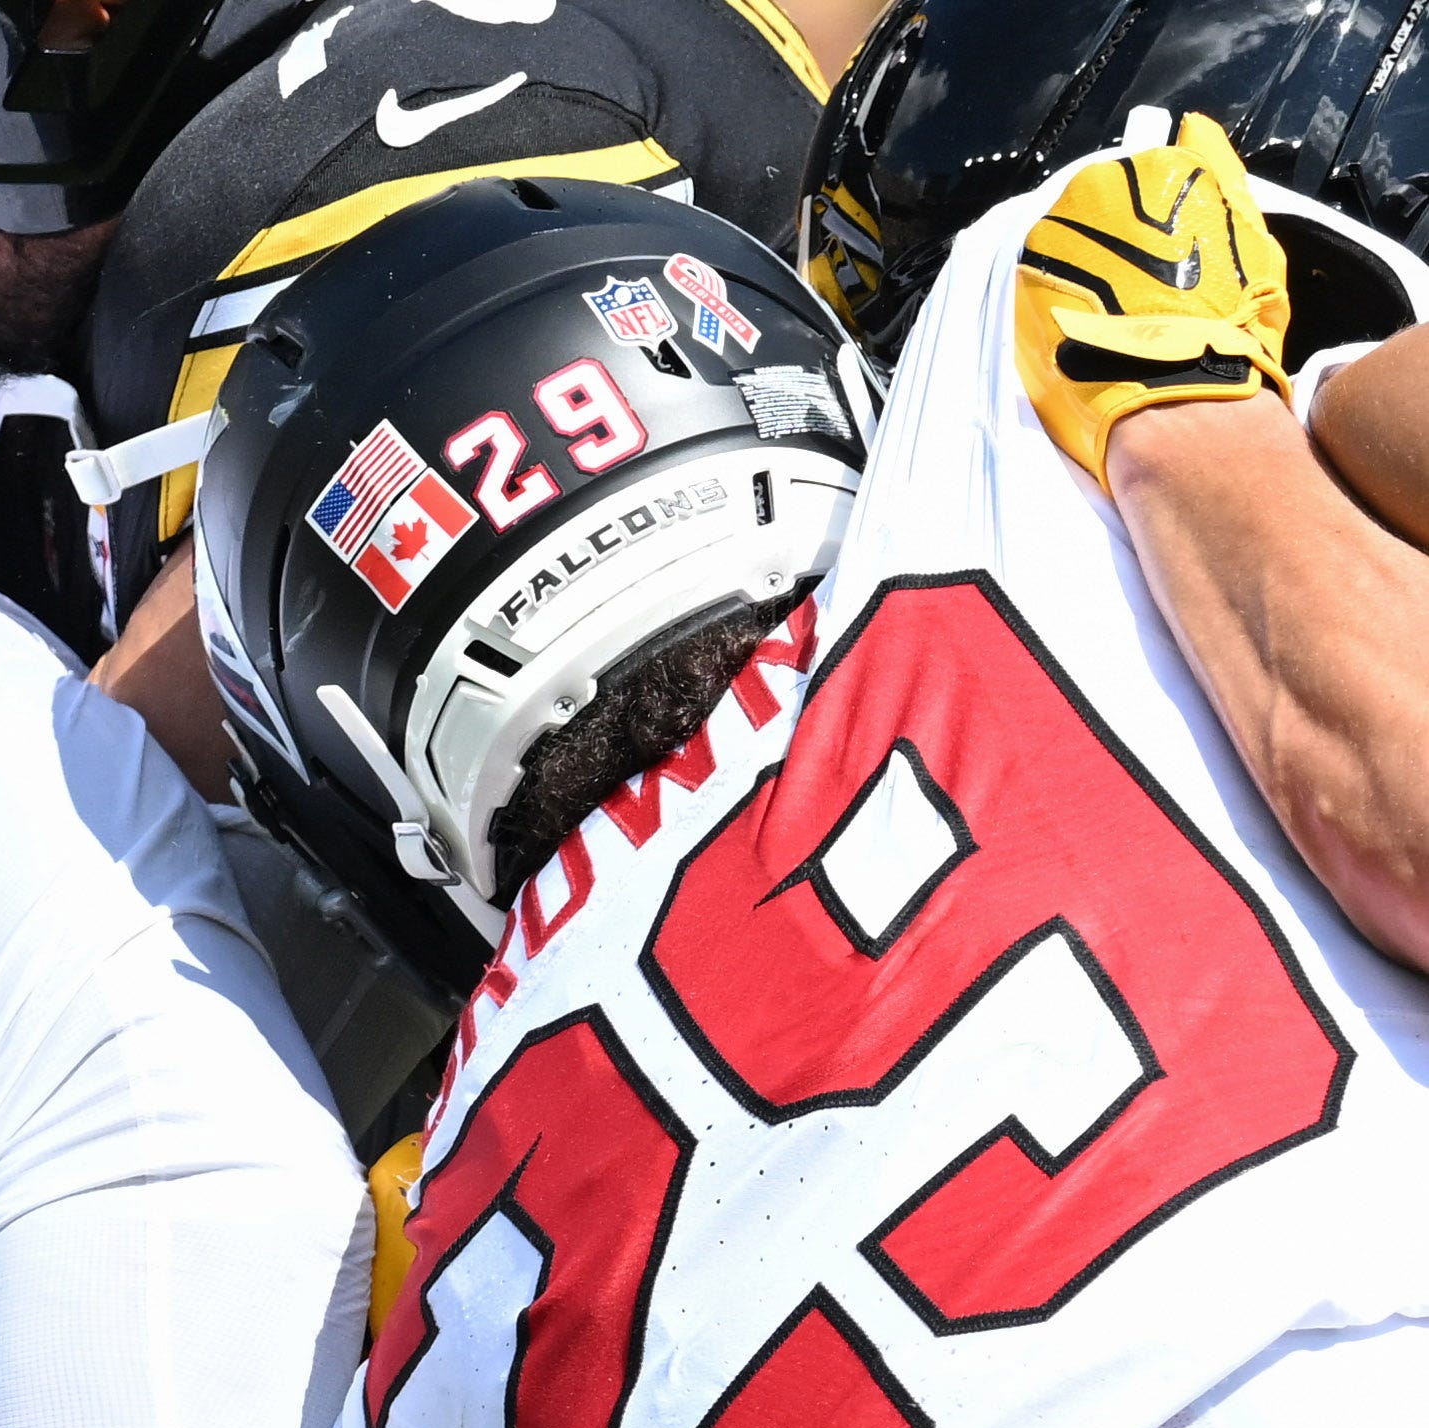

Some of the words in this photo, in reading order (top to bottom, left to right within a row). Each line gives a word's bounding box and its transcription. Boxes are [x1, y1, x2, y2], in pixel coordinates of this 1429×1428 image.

[609, 303, 668, 337] NFL
[441, 357, 649, 536] 29
[498, 478, 729, 627] FALCONS
